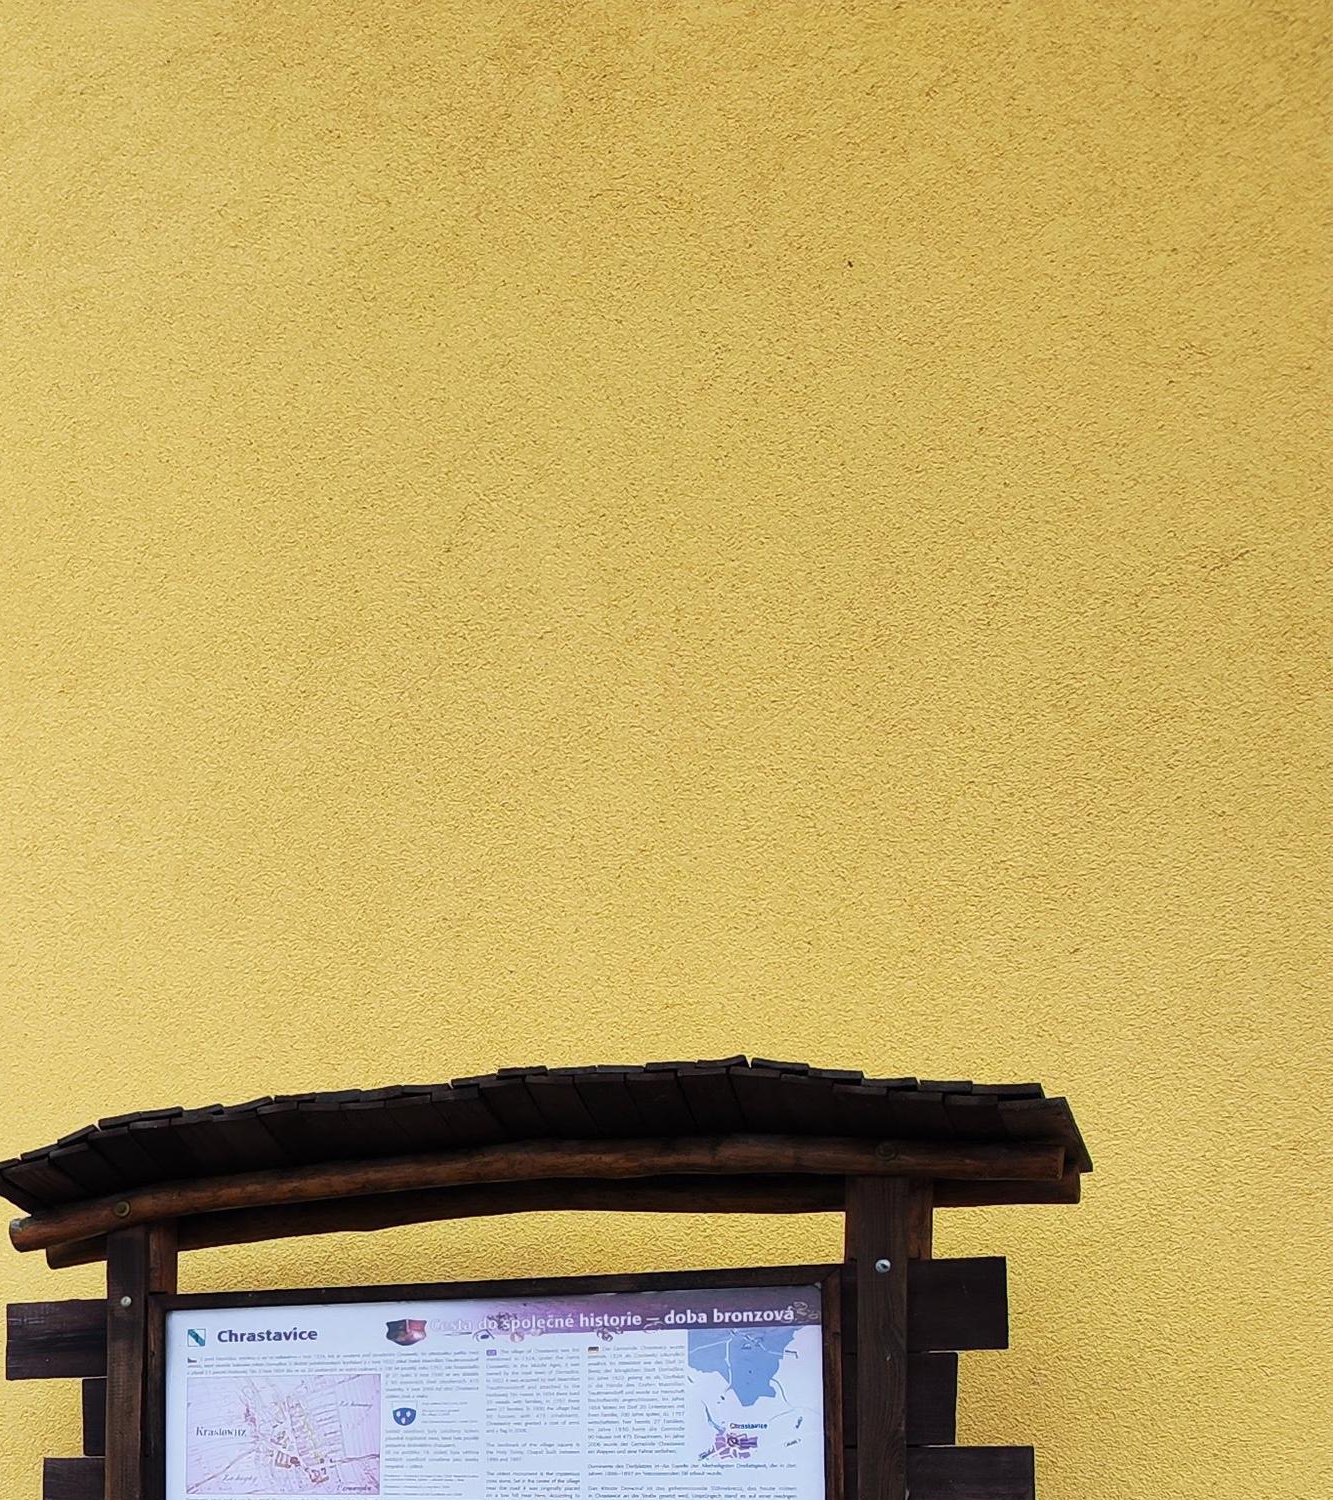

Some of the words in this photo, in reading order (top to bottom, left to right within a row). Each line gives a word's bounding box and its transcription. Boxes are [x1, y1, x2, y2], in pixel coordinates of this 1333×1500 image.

[479, 1315, 498, 1329] do
[503, 1312, 574, 1332] společné
[579, 1311, 642, 1329] historie
[664, 1308, 708, 1325] doba
[713, 1304, 796, 1323] bronzová
[217, 1327, 318, 1343] Chrastavice
